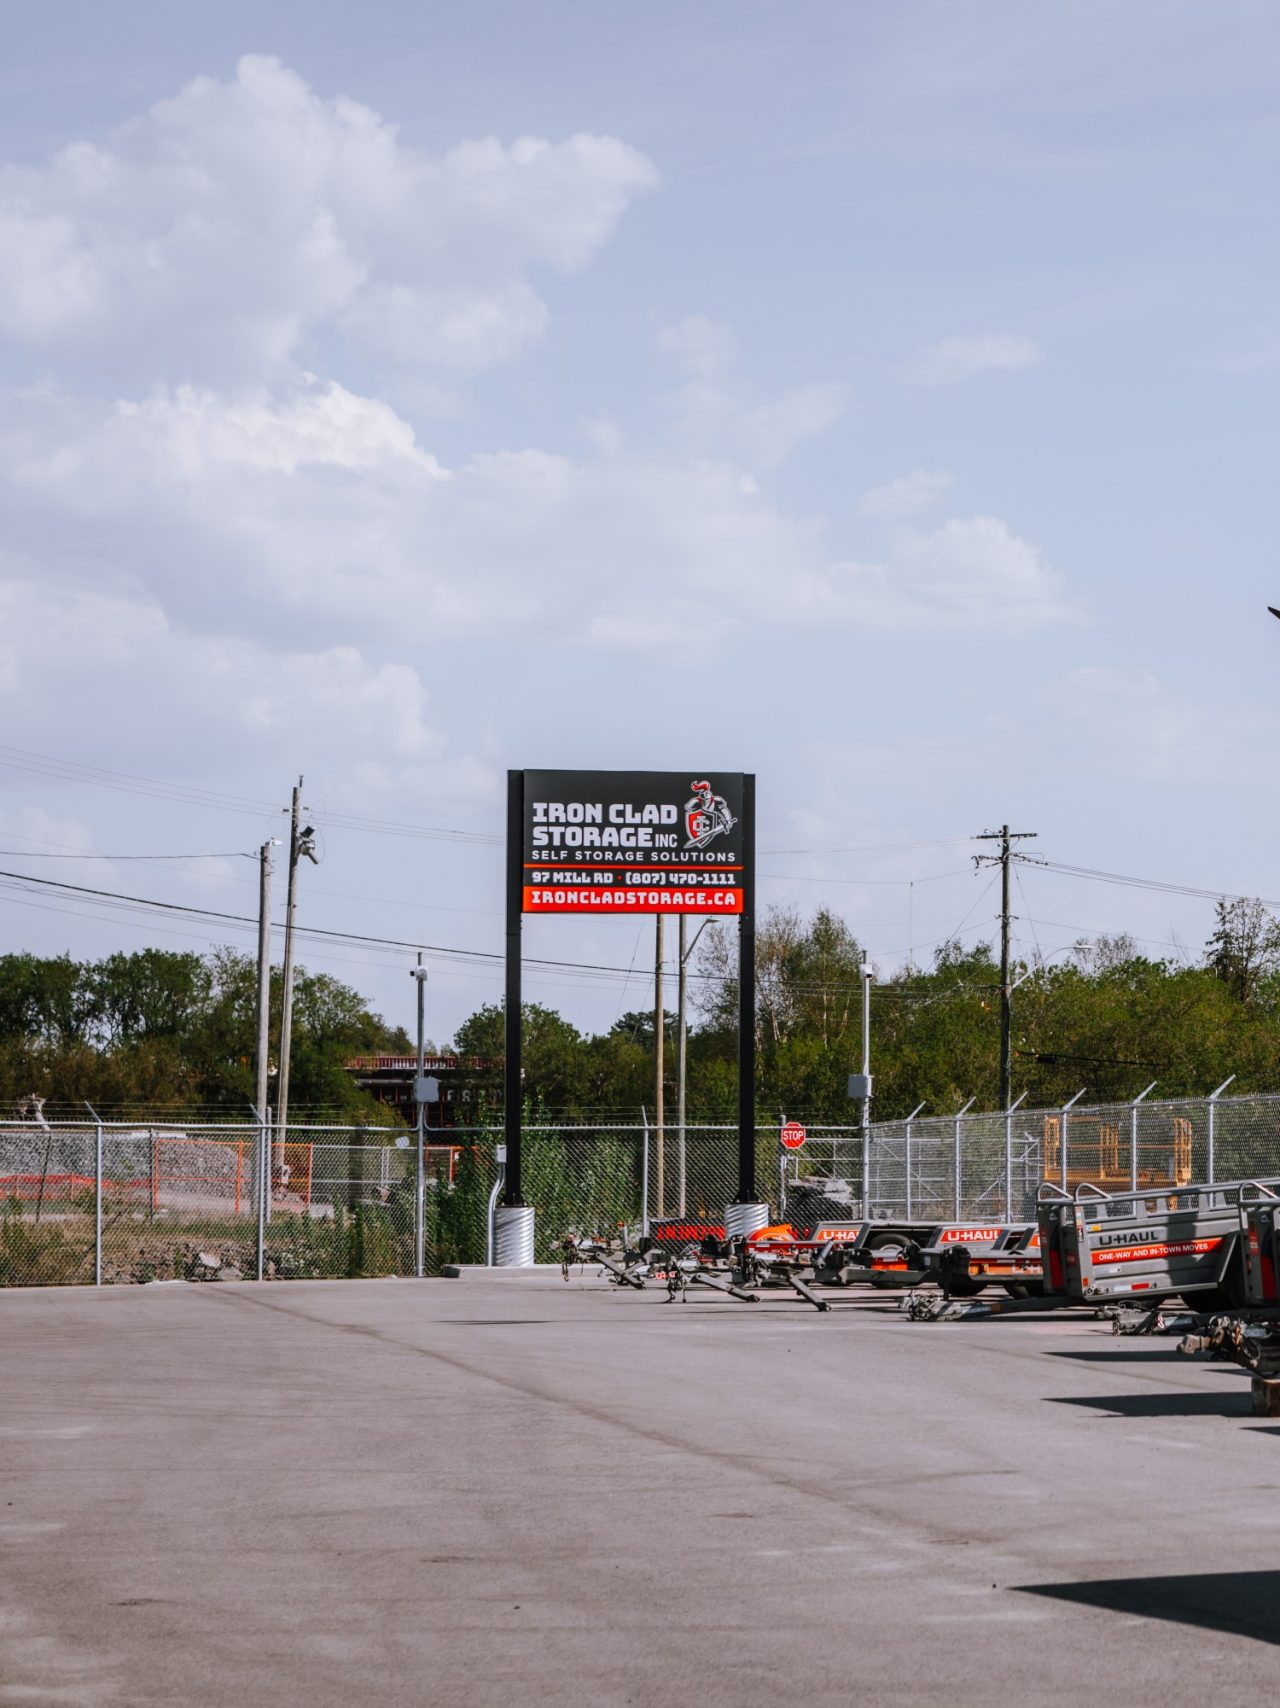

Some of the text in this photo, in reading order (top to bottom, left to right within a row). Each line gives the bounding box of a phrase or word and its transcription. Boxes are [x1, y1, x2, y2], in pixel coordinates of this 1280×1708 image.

[532, 802, 678, 824] IRON CLAD
[532, 826, 678, 848] STORAGE INC
[531, 850, 736, 862] SELF STORAGE SOLUTIONS
[531, 871, 736, 885] 97 MILL RD (807) 470-1111
[531, 891, 736, 906] IRONCLADSTORAGE.CA
[783, 1130, 804, 1141] STOP
[1099, 1231, 1158, 1246] U-HAUL
[1098, 1242, 1208, 1261] ONE-WAY AND IN-TOWN MOVES
